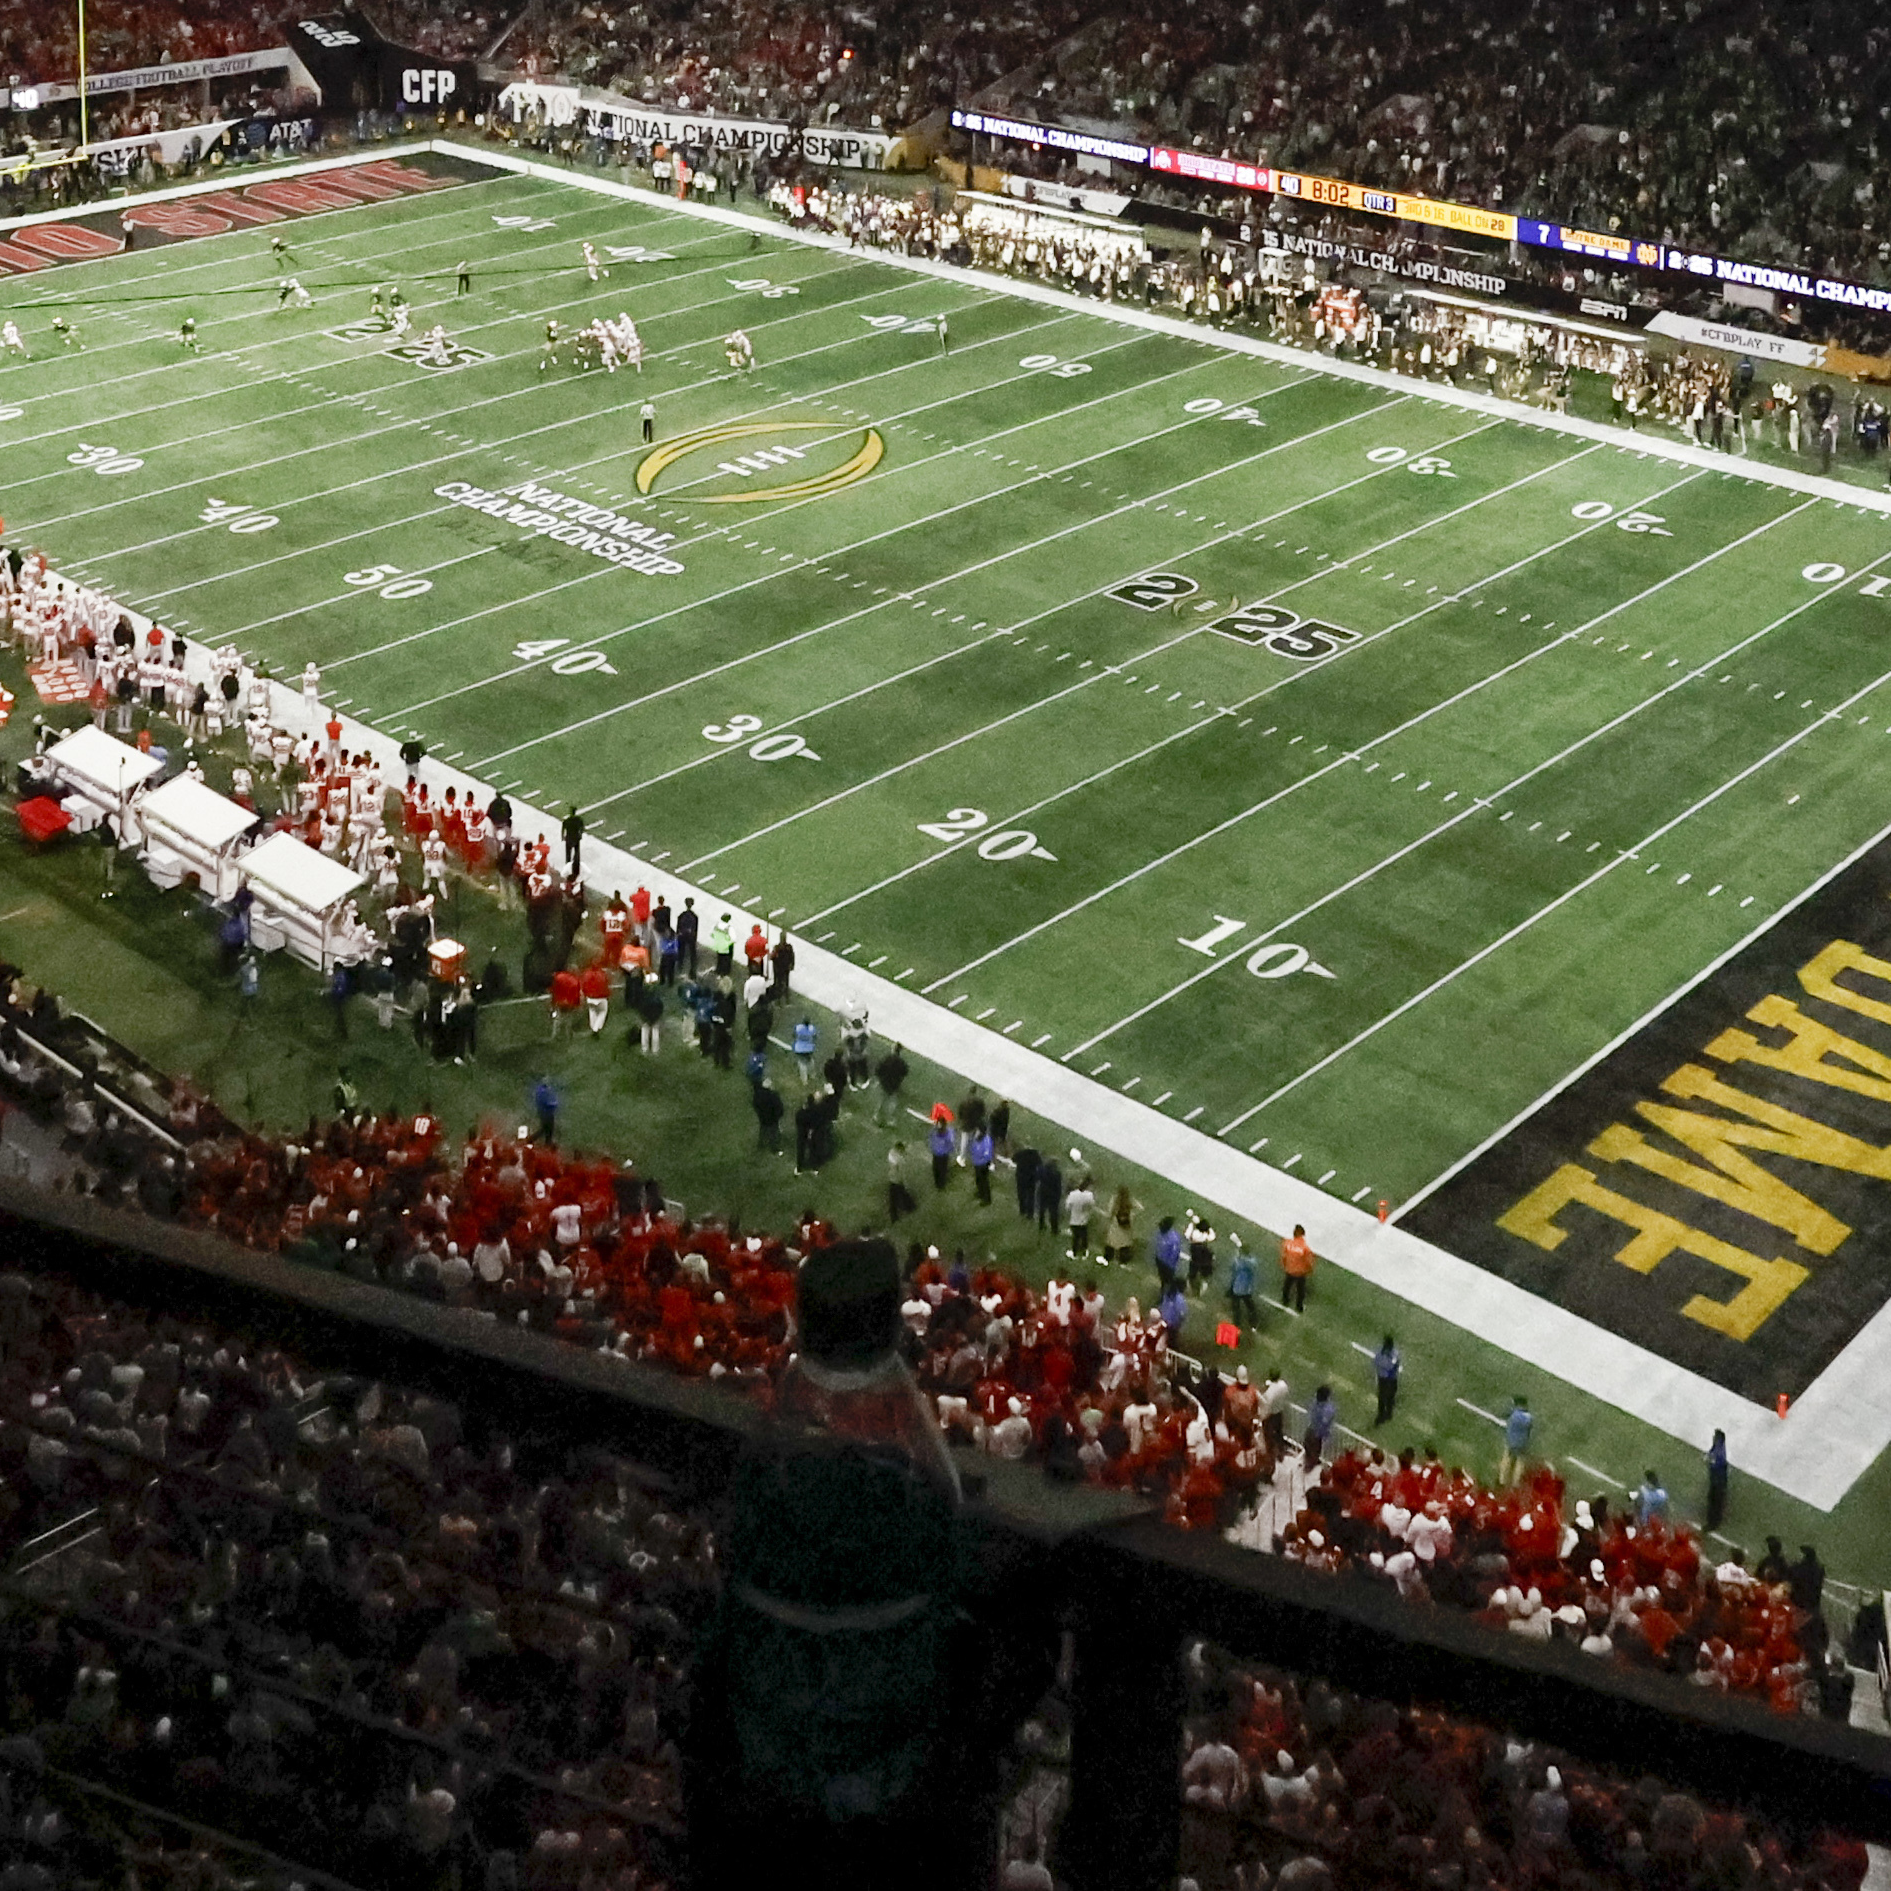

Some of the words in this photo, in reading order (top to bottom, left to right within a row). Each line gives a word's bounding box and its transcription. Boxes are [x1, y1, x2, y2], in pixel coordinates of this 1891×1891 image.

[136, 66, 200, 87] FOOTBALL
[402, 69, 456, 103] CFP
[12, 88, 38, 108] 40
[269, 118, 312, 142] AT&T
[120, 160, 463, 237] STATE
[984, 117, 1048, 144] NATIONAL
[1048, 130, 1149, 163] CHAMPIONSHIP
[1202, 157, 1235, 173] STATE
[1237, 167, 1256, 185] 28
[1281, 175, 1299, 194] 40
[1313, 179, 1350, 204] 8:02
[1363, 190, 1385, 209] QTR
[1385, 196, 1395, 211] 3
[1433, 206, 1445, 220] 16
[1450, 211, 1472, 227] BALL
[1490, 218, 1505, 232] 28
[1538, 224, 1550, 244] 7
[1565, 229, 1597, 245] NOTRE
[1599, 236, 1628, 250] DAME
[1715, 260, 1813, 295] NATIONAL
[1580, 298, 1628, 322] ESPN
[1019, 354, 1092, 379] 50
[1184, 399, 1266, 428] 40
[67, 443, 146, 476] 30
[1366, 446, 1457, 478] 30
[198, 498, 279, 534] 40
[433, 482, 685, 575] CHAMPIONSHIP
[505, 483, 676, 550] NATIONAL
[1571, 501, 1674, 537] 20
[342, 563, 434, 599] 50
[511, 638, 608, 675] 40
[702, 715, 807, 761] 30
[918, 808, 1039, 862] 20
[1178, 915, 1310, 979] 10
